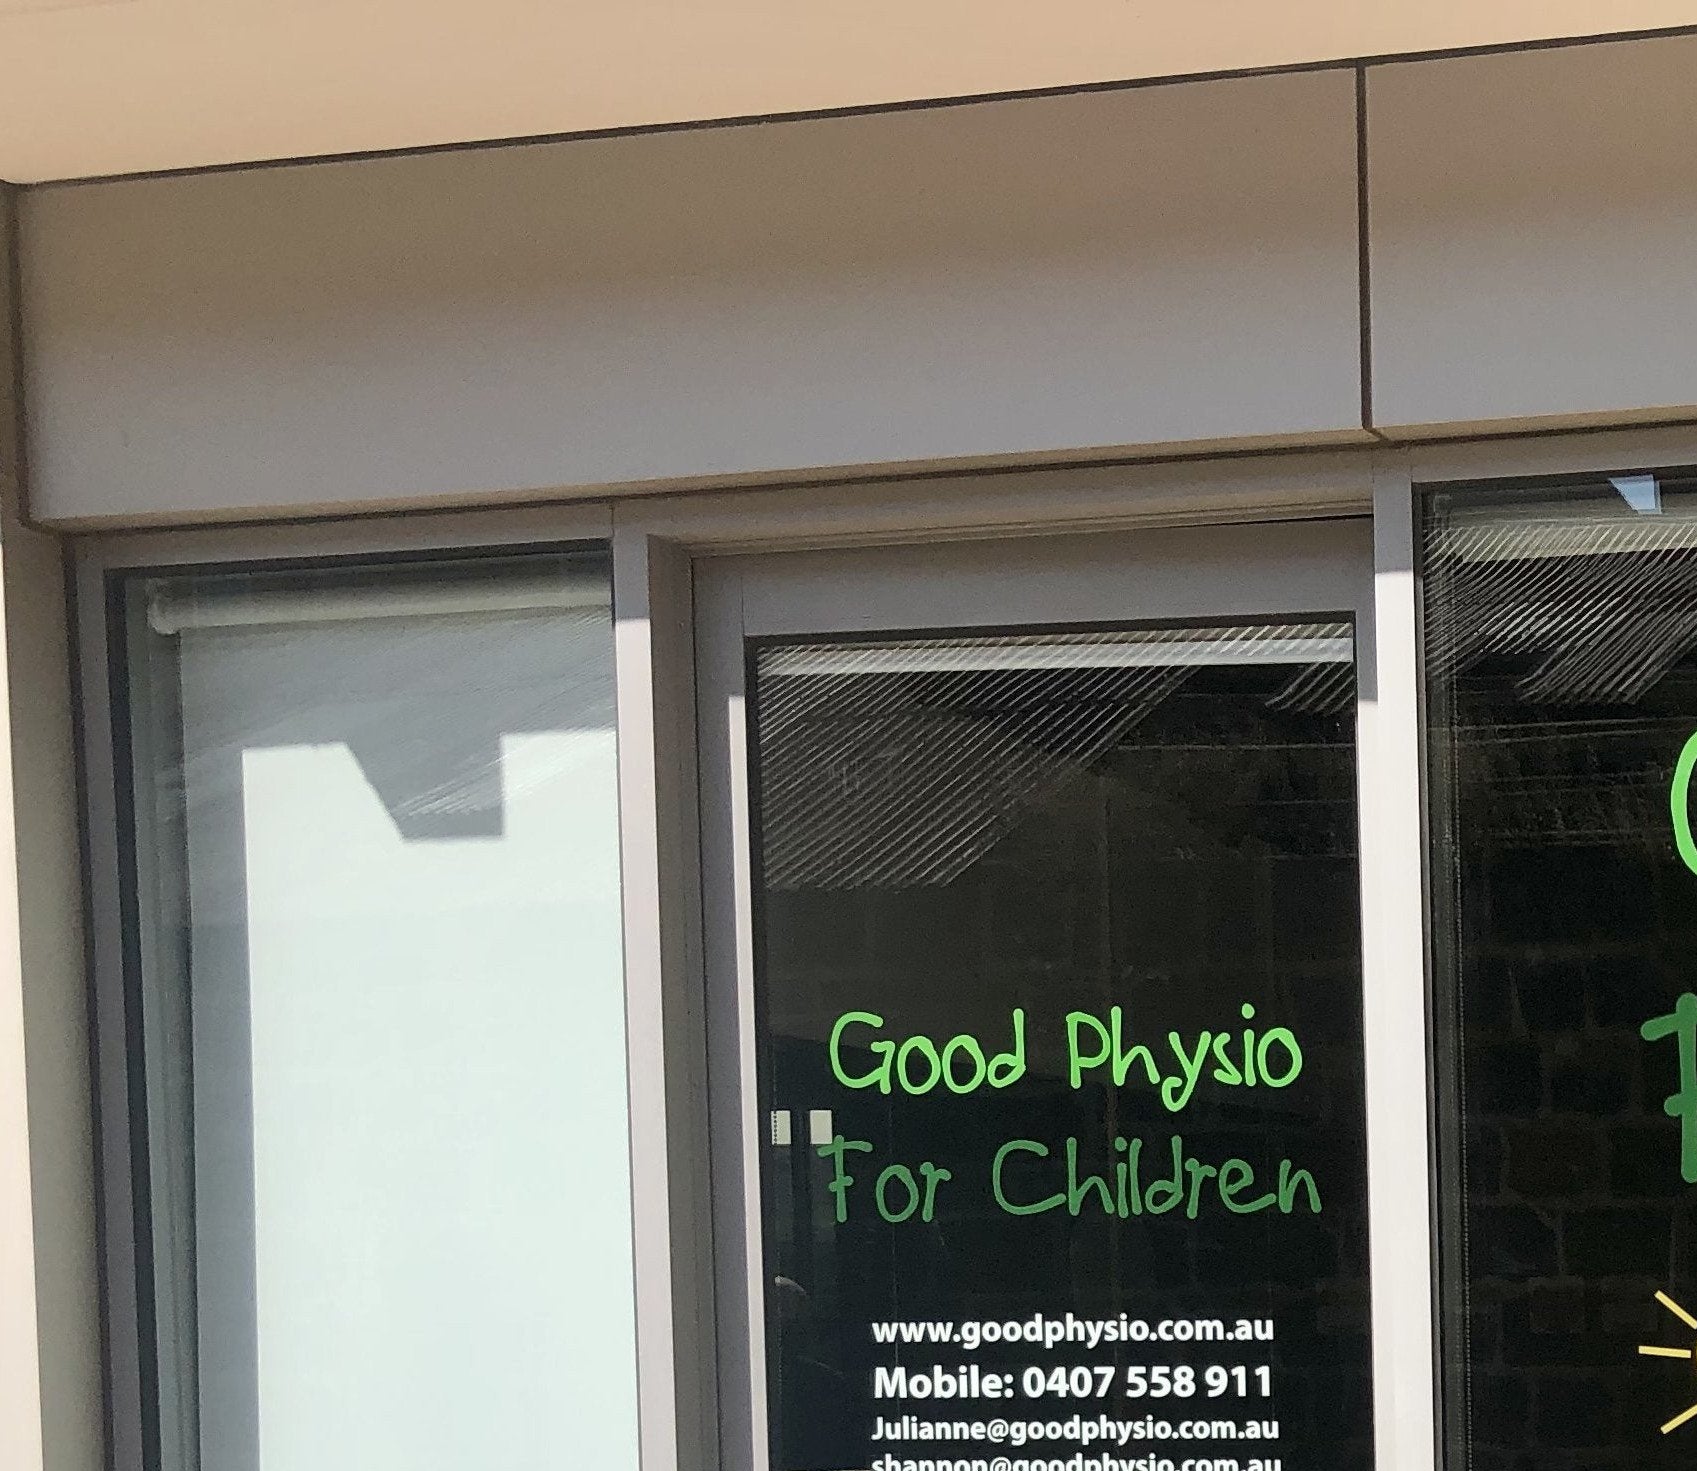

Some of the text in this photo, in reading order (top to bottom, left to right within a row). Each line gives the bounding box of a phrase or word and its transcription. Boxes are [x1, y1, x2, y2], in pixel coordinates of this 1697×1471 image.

[829, 1003, 1303, 1111] Good Physio
[817, 1135, 1322, 1222] For Children
[871, 1312, 1275, 1349] www.goodphysio.com.au
[873, 1364, 1272, 1400] Mobile: 0407 558 911
[871, 1413, 1280, 1447] Julianne@goodphysio.com.au
